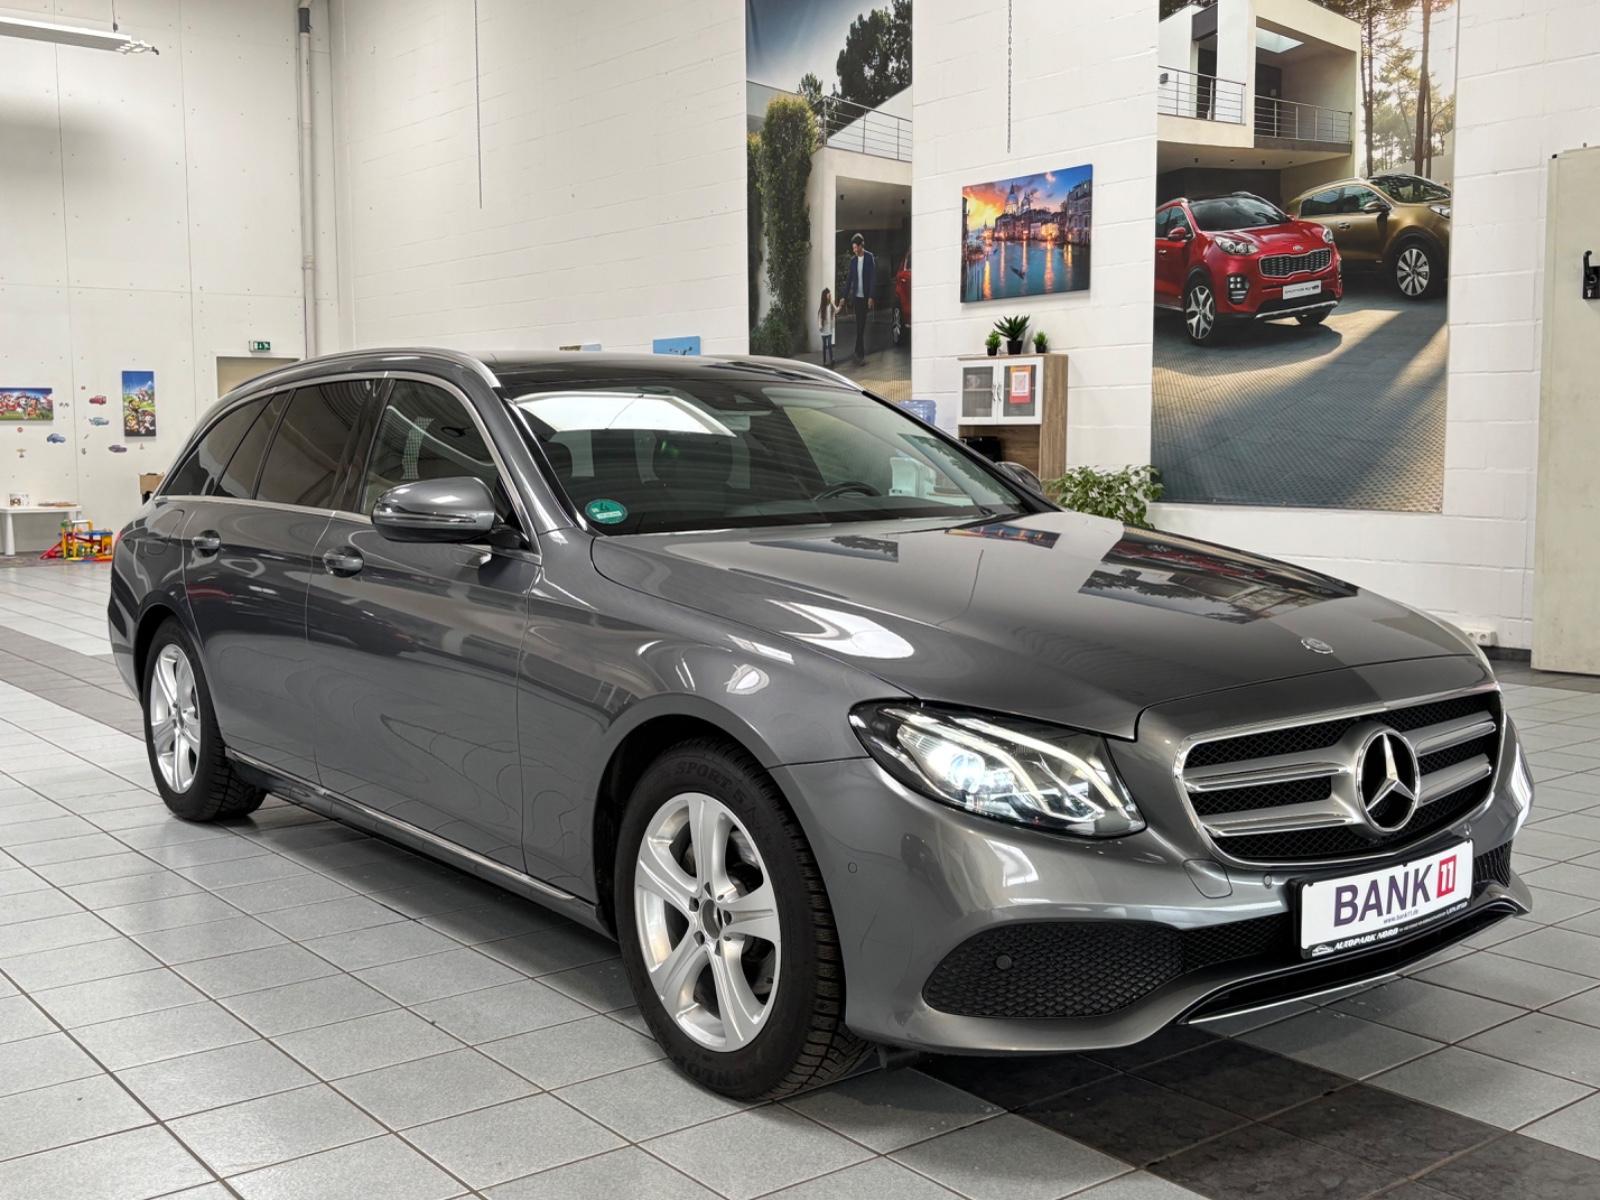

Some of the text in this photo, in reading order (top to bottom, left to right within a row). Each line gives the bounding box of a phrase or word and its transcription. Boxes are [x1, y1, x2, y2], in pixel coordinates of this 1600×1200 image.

[1334, 863, 1432, 927] BANK
[1334, 927, 1399, 951] AUTOPARK NORD
